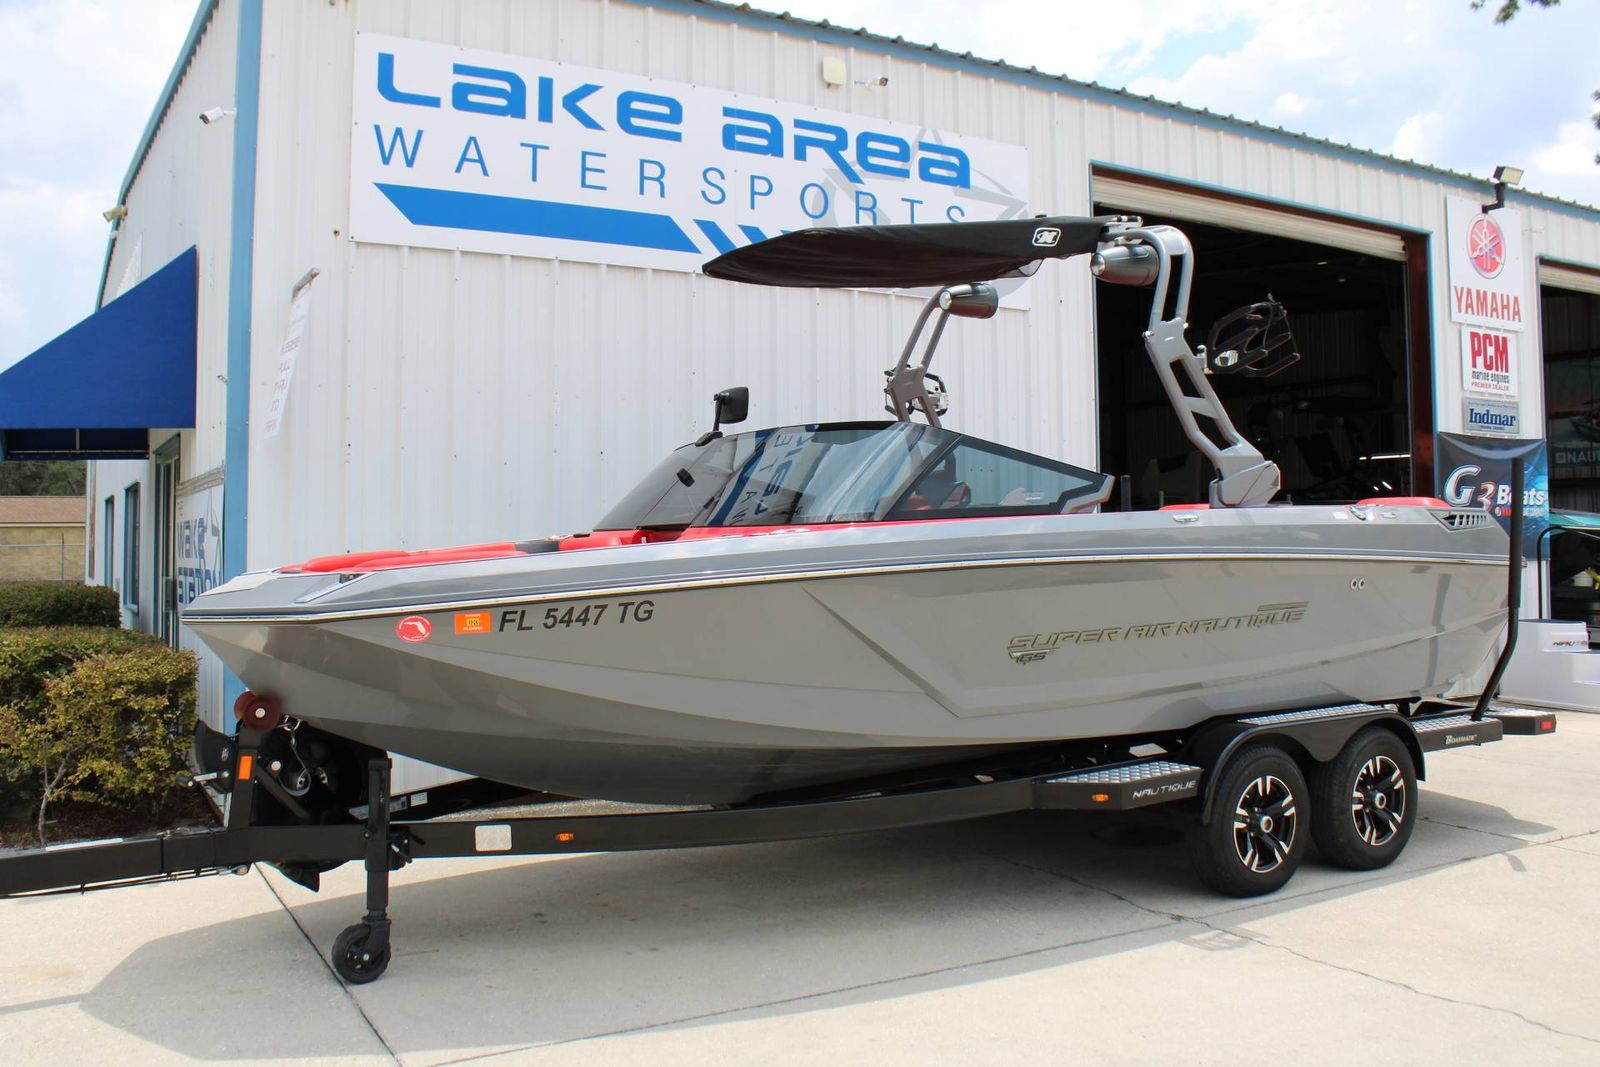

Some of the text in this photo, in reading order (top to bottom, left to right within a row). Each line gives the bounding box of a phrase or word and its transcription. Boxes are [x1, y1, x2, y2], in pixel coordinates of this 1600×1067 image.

[374, 124, 965, 225] WATERSPORTS
[1454, 285, 1521, 322] YAMAHA
[1470, 331, 1509, 373] PCM
[1469, 408, 1516, 427] Indmar
[498, 600, 656, 633] FL 5447 TG
[1008, 609, 1306, 650] SUPER AIR NAUTIQUE
[1132, 780, 1198, 799] NAUTIQUE
